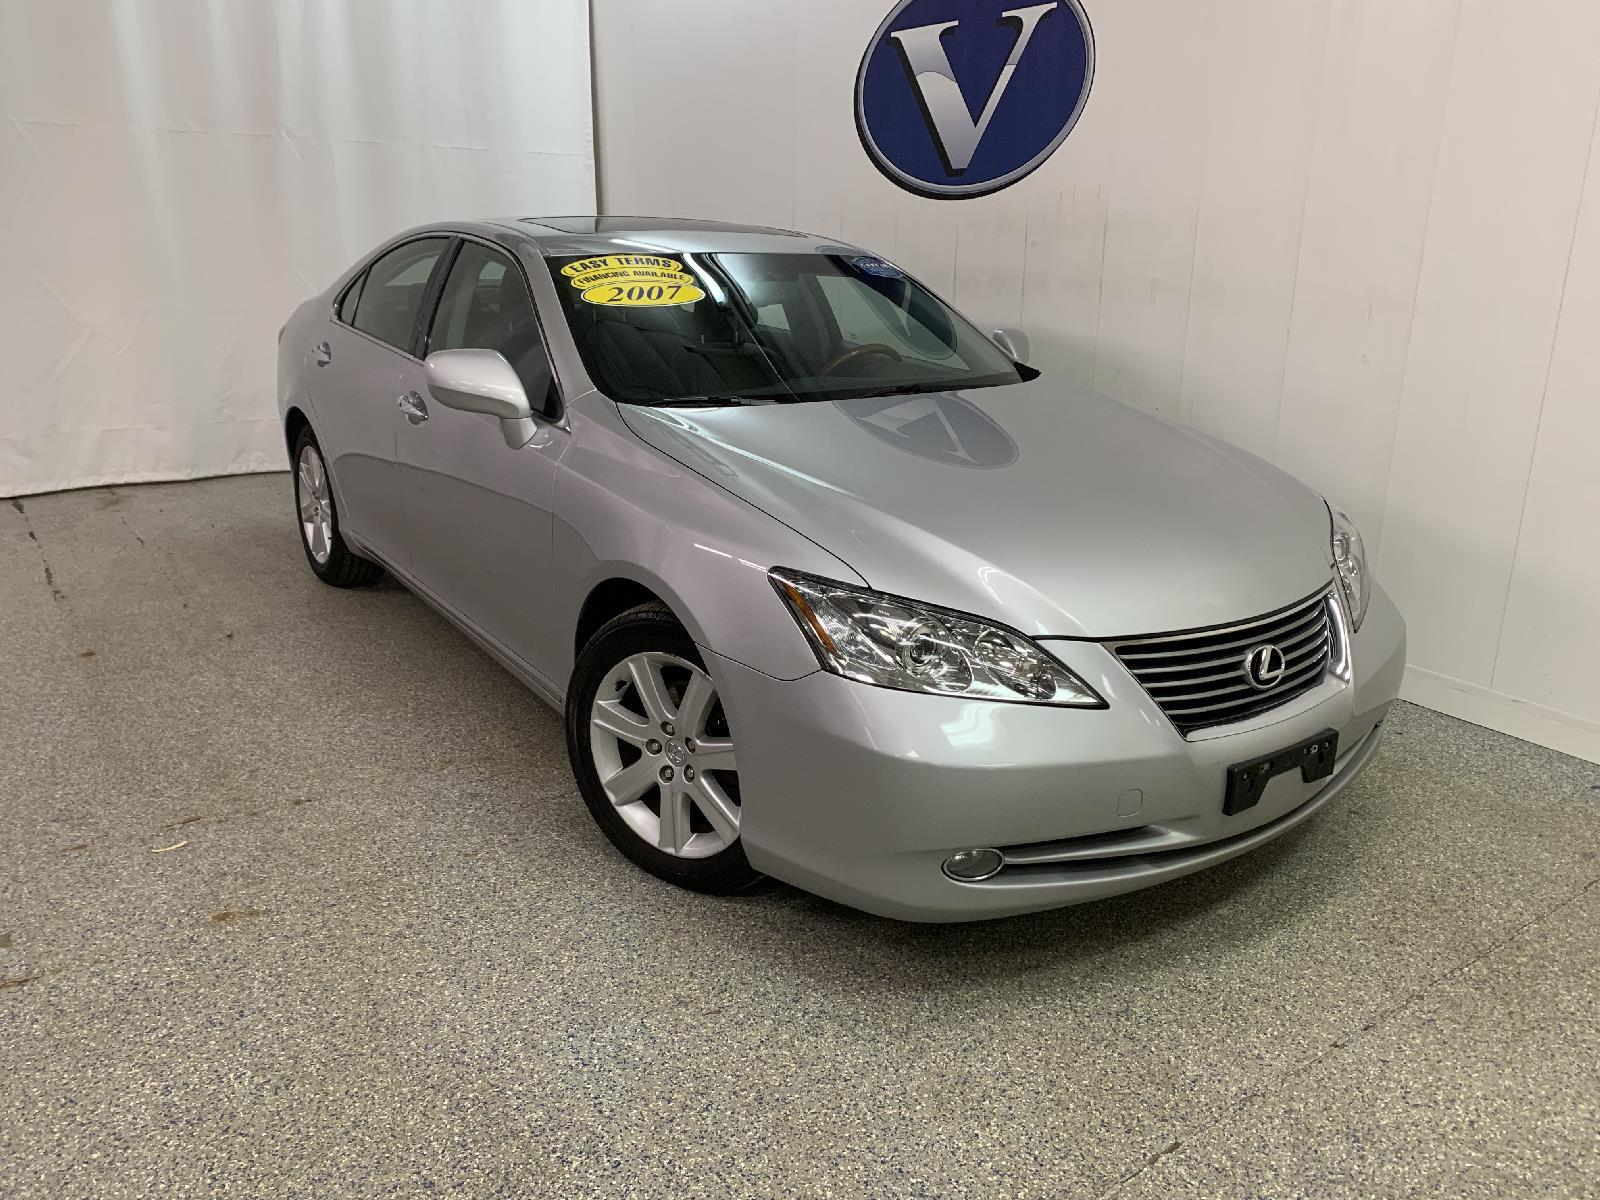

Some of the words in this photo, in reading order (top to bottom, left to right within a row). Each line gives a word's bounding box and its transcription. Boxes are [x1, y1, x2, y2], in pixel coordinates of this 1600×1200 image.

[887, 2, 1057, 177] V
[569, 259, 609, 273] EASY
[614, 257, 673, 268] TERMS
[577, 270, 630, 285] FINANCING
[633, 270, 685, 280] AVAILABLE
[606, 285, 684, 302] 2007
